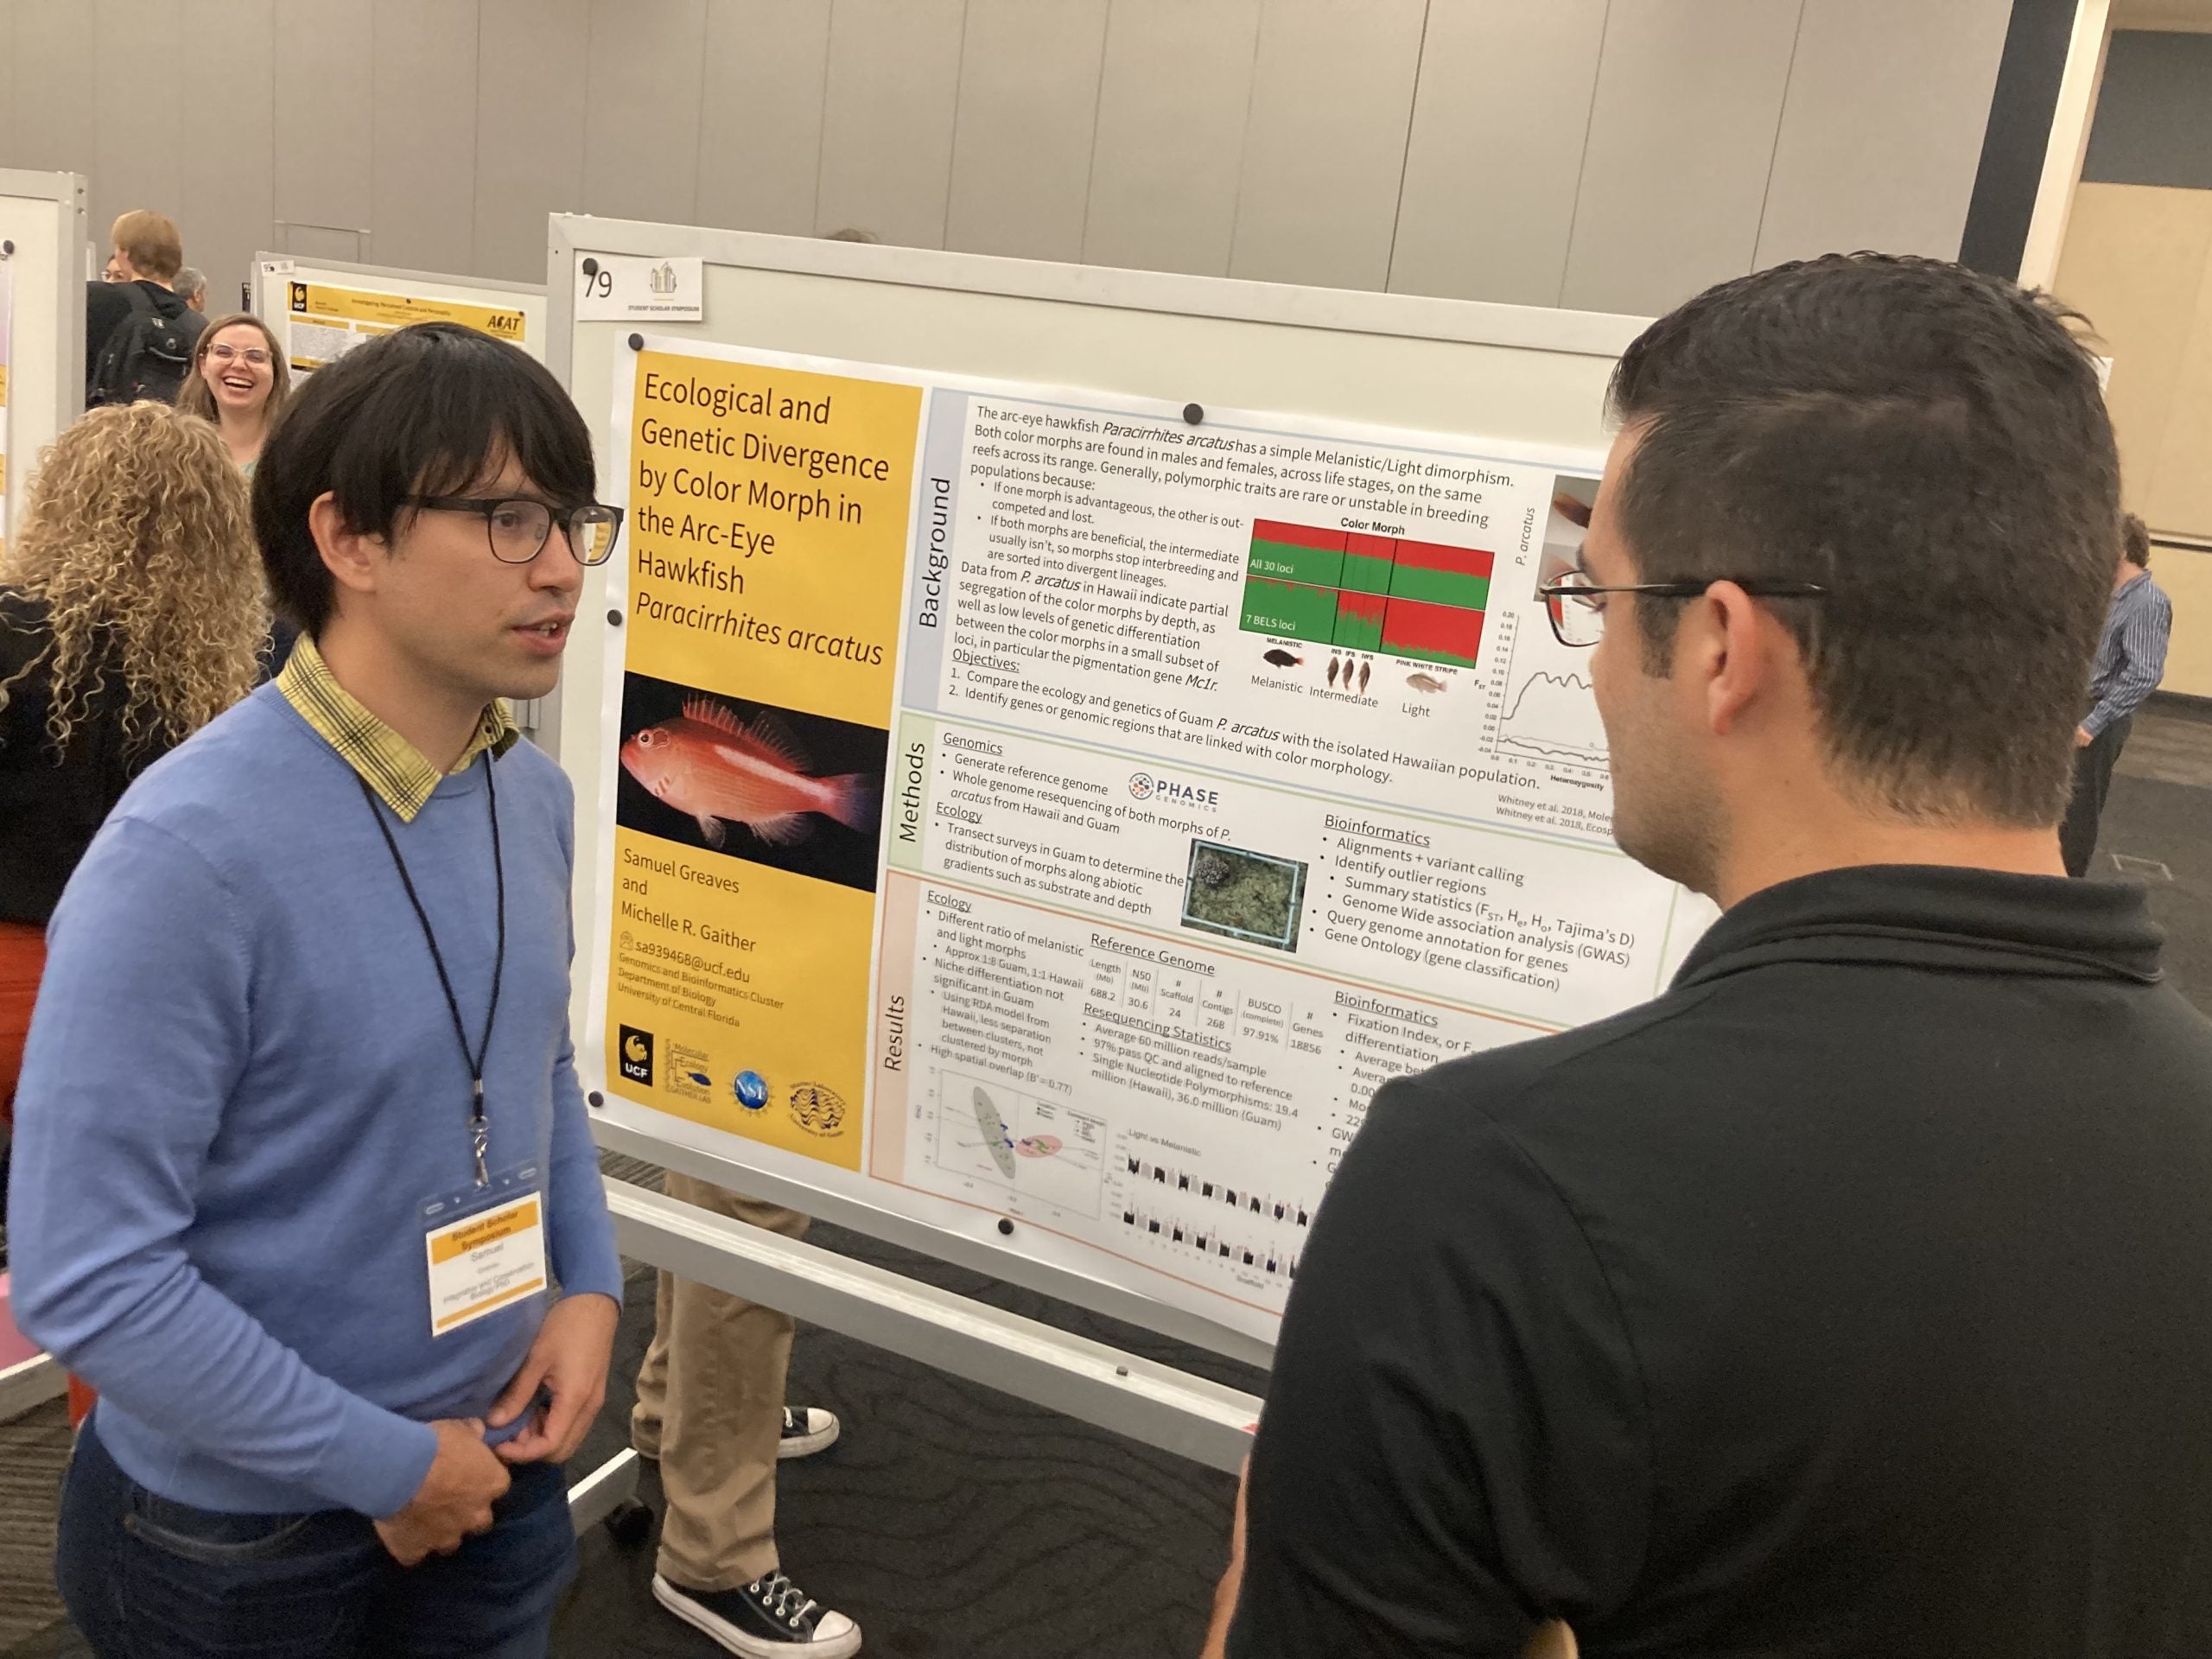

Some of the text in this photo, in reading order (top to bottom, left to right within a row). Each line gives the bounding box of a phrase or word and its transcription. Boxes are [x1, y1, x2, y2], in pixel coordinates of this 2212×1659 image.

[582, 270, 612, 298] 79
[645, 372, 831, 424] Ecological and
[641, 417, 889, 481] Genetic Divergence
[978, 405, 1513, 487] The arc-eye hawkfish Paracirrhites arcatus has a simple Melanistic/Light dimorphism.
[639, 460, 861, 524] by Color Morph in
[970, 464, 1096, 491] populations because:
[972, 444, 1490, 529] reefs across its range. Generally, polymorphic traits are rare or unstable in breeding
[638, 505, 774, 558] the Arc-Eye
[1340, 517, 1405, 536] Color Morph
[1518, 507, 1535, 550] arcatus
[919, 477, 950, 627] Background
[1249, 556, 1294, 574] All 30 loci
[638, 549, 743, 594] Hawkfish
[636, 591, 883, 665] Paracirrhites arcatus
[1246, 613, 1296, 631] 7 BELS loci
[951, 649, 1020, 672] Objectives:
[1251, 674, 1303, 694] Melanistic
[1309, 685, 1378, 708] Intermediate
[1402, 702, 1430, 718] Light
[943, 732, 1003, 755] Genomics
[948, 684, 1392, 785] 2. Identify genes or genomic regions that are linked with color morphology.
[950, 667, 1540, 789] 1. Compare the ecology and genetics of Guam P. arcatus with the isolated Hawaiian population.
[955, 753, 1108, 796] Generate reference genome
[899, 742, 925, 842] Methods
[953, 769, 1230, 842] Whole genome resequencing of both morphs of P.
[1155, 795, 1217, 812] GENOMICS
[1156, 779, 1219, 805] PHASE
[936, 802, 982, 824] Ecology
[1323, 813, 1430, 846] Bioinformatics
[623, 848, 739, 893] Samuel Greaves
[1335, 855, 1486, 896] Identify outlier regions
[1336, 836, 1524, 887] Alignments + variant calling
[622, 877, 648, 895] and
[927, 890, 972, 912] Ecology
[621, 899, 757, 952] Michelle R. Gaither
[1342, 893, 1630, 968] Genome Wide association analysis (GWAS)
[635, 941, 750, 983] sa939468@ucf.edu
[1090, 933, 1216, 976] Reference Genome
[1132, 969, 1152, 982] N50
[1090, 988, 1116, 1001] 688.2
[1128, 997, 1148, 1010] 30.6
[1248, 998, 1281, 1014] BUSCO
[1334, 990, 1439, 1027] Bioinformatics
[1084, 1002, 1232, 1052] Resequencing Statistics
[1168, 1007, 1181, 1018] 24
[1206, 1017, 1225, 1030] 268
[885, 995, 905, 1071] Results
[1243, 1027, 1279, 1044] 97.91%
[1290, 1039, 1322, 1055] 18856
[1345, 1032, 1439, 1063] differentiation
[625, 1062, 649, 1077] UCF
[452, 1211, 518, 1241] Student Scholar
